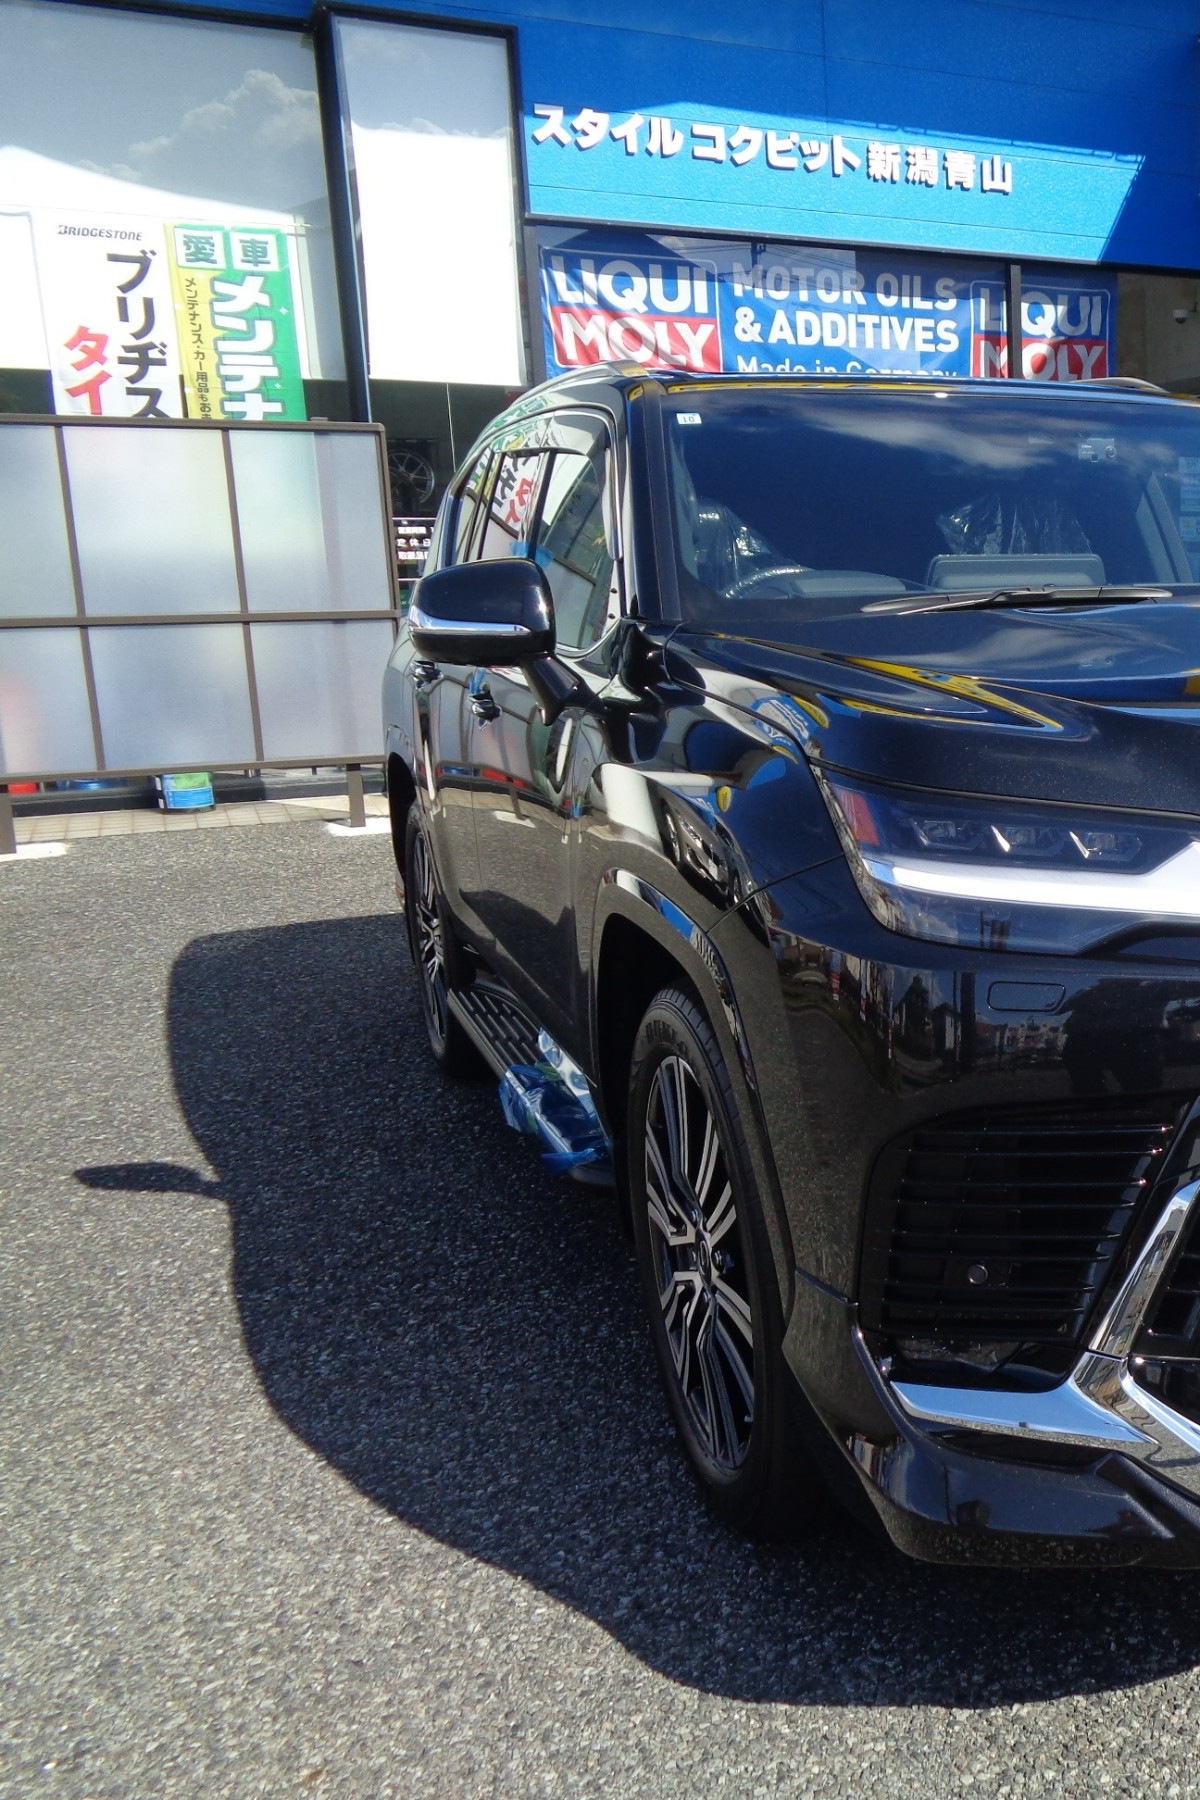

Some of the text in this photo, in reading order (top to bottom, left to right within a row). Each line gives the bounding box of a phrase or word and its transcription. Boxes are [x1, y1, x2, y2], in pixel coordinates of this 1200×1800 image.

[58, 225, 143, 241] BRIDGESTONE
[183, 234, 271, 267] 愛車
[551, 256, 708, 313] LIQUI
[732, 262, 957, 311] MOTOR OILS
[106, 249, 168, 417] ブリヂス
[211, 275, 284, 420] メンテナ
[560, 313, 715, 368] MOLY
[734, 306, 959, 352] & ADDITIVES
[63, 325, 112, 415] タイ
